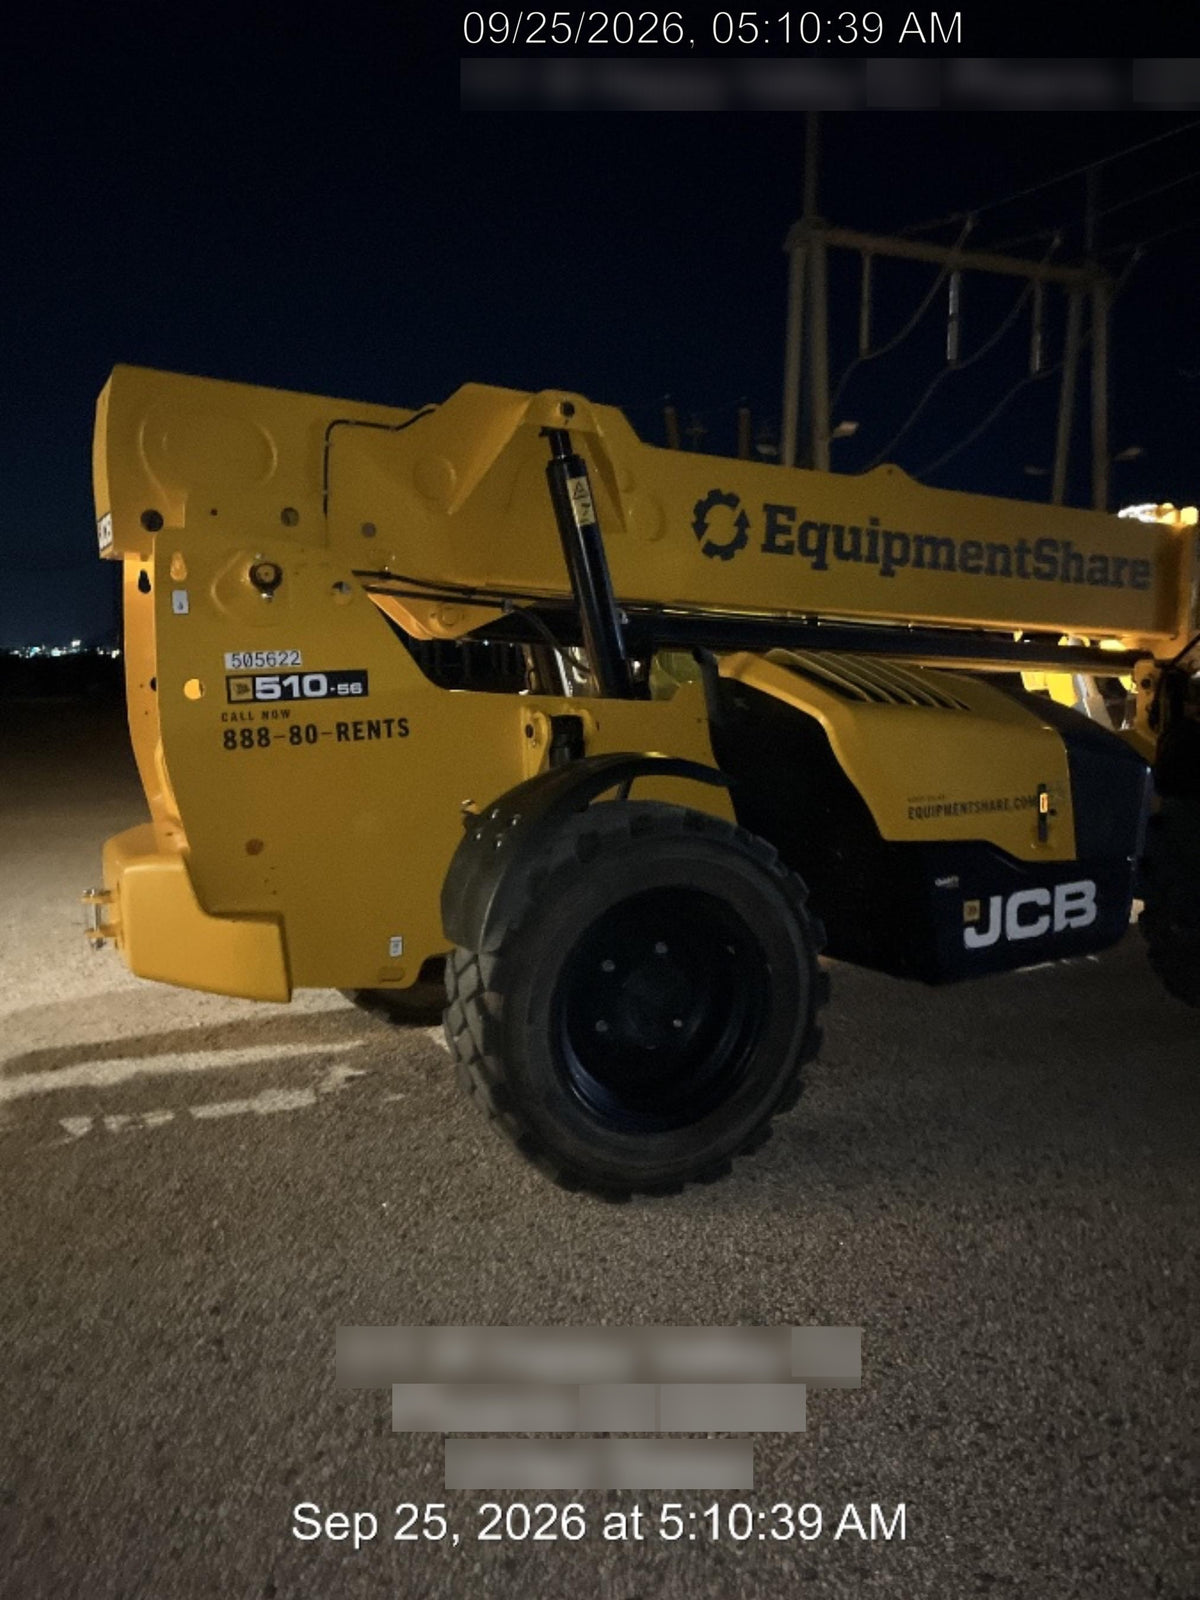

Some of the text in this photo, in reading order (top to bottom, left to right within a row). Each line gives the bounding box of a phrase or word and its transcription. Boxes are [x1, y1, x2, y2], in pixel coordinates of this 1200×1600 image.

[761, 503, 1151, 590] EquipmentShare
[231, 650, 301, 669] 505622
[221, 709, 291, 722] CALL NOW
[223, 718, 410, 750] 888-80-RENTS
[963, 880, 1097, 949] JCB
